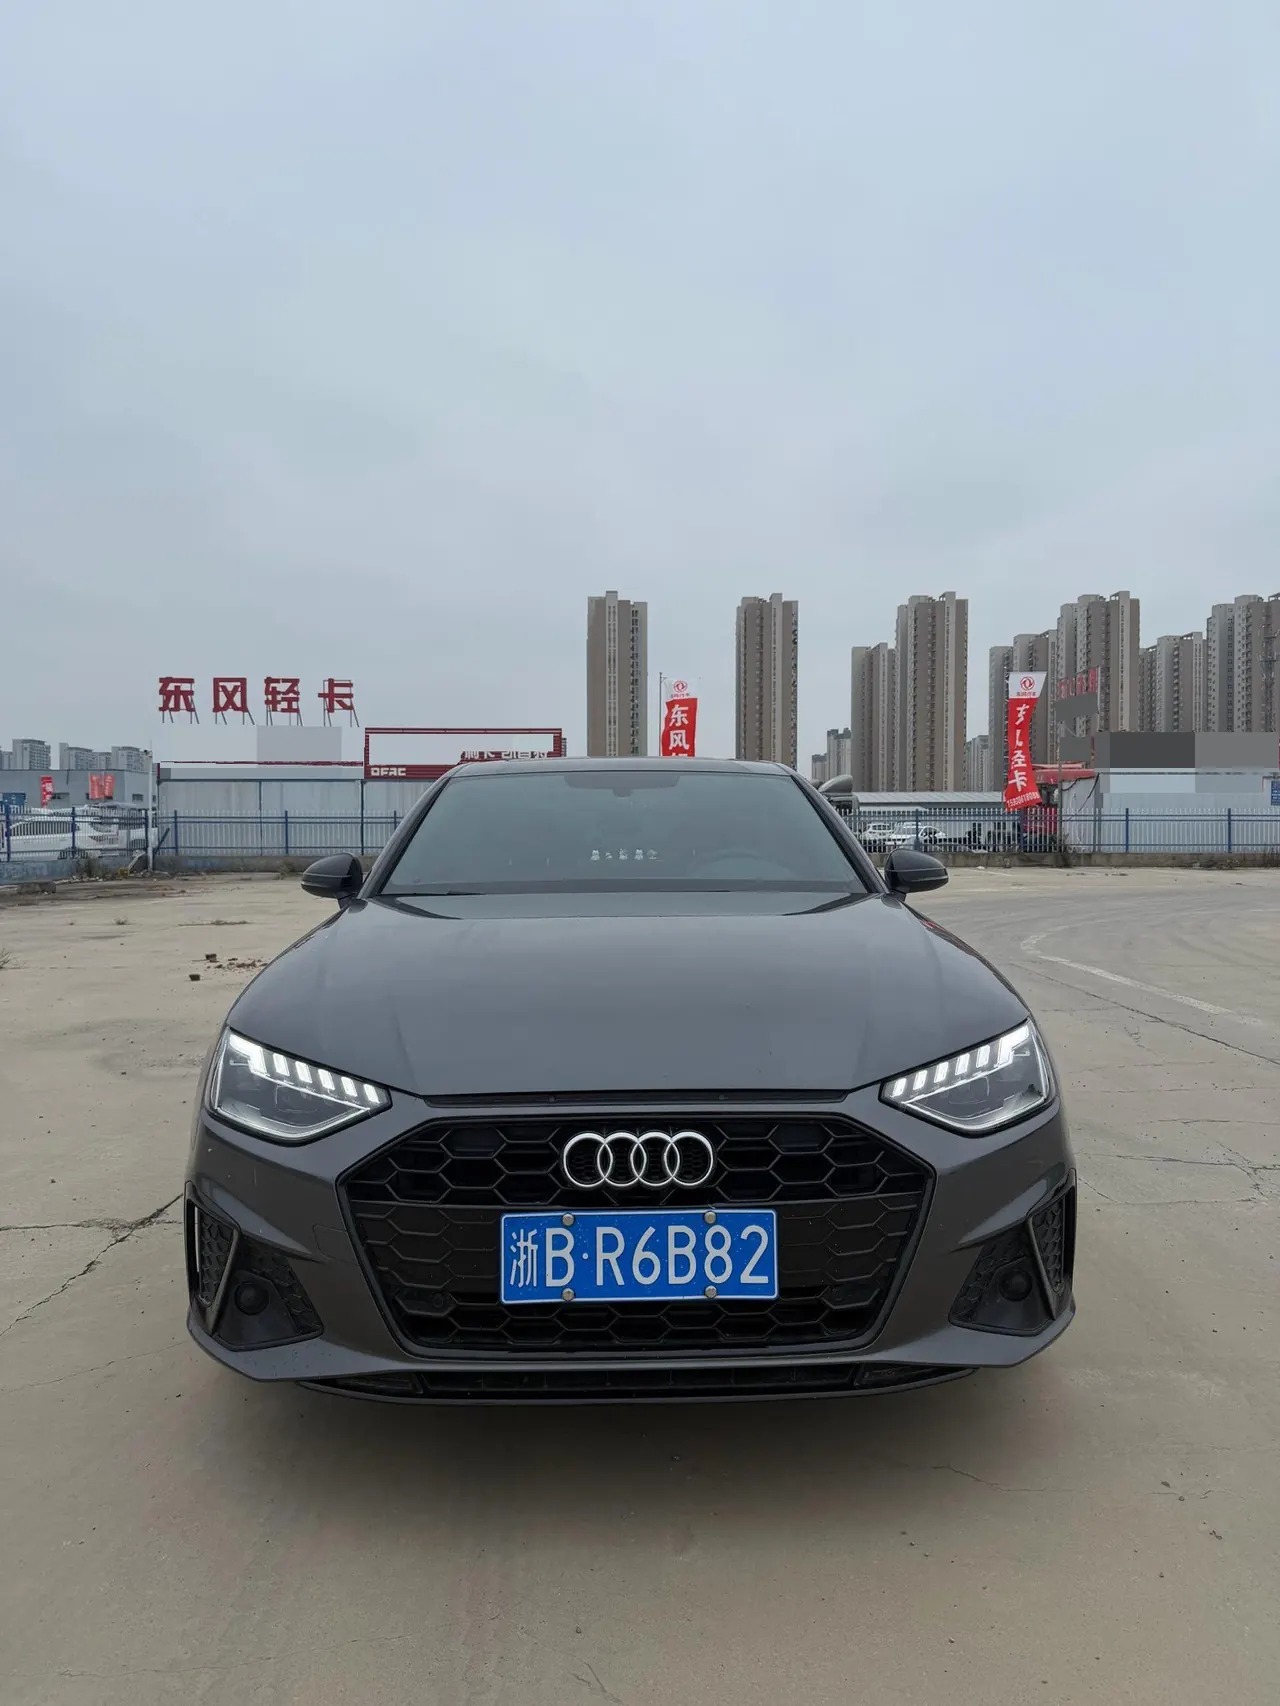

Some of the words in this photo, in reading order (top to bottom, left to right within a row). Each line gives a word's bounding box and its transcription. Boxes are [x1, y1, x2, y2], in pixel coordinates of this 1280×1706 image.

[159, 676, 354, 713] 东风轻卡
[669, 704, 690, 757] 东风
[509, 1224, 770, 1288] 浙B·R6B82
